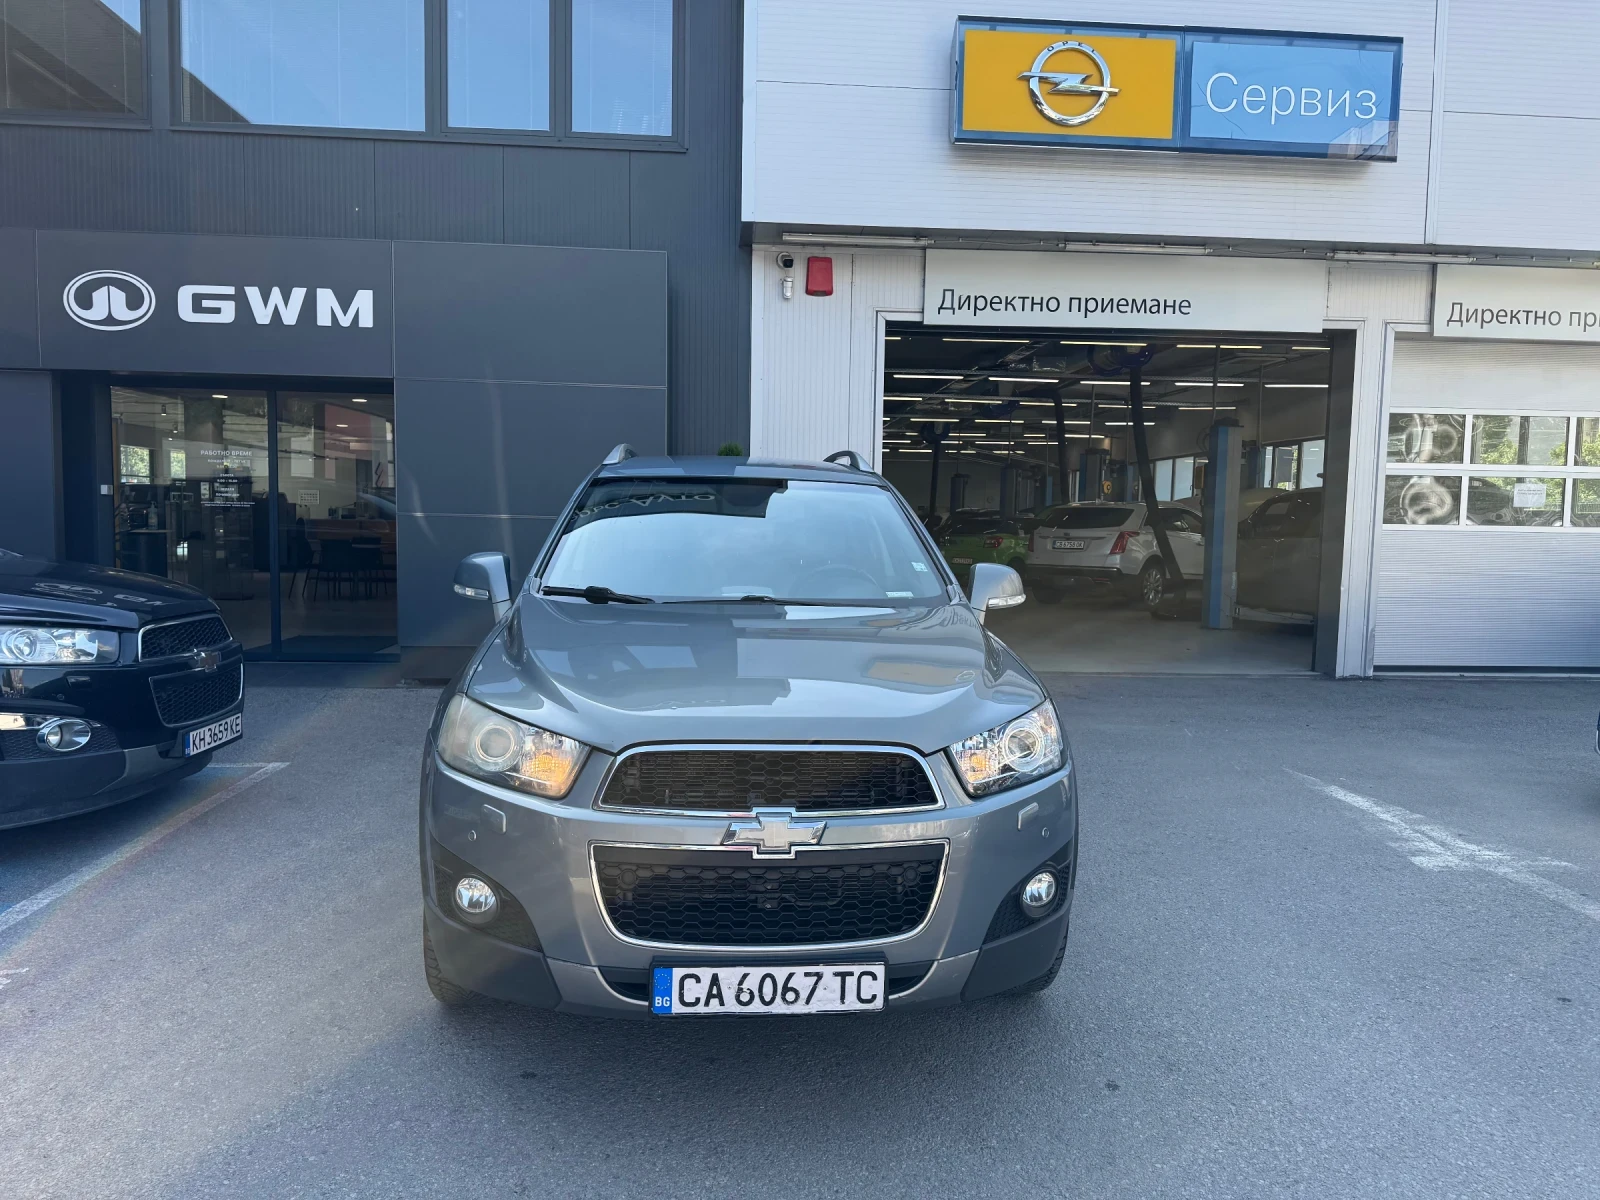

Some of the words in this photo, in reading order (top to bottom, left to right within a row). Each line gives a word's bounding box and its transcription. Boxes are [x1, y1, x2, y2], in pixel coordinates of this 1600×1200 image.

[1046, 40, 1097, 55] OPEL
[1206, 72, 1377, 125] Сервиз
[177, 284, 374, 328] GWM
[938, 288, 1061, 316] Директно
[1068, 296, 1192, 318] приемане
[1446, 302, 1562, 329] Директно
[1569, 311, 1600, 332] пр
[192, 729, 206, 752] KH
[207, 721, 229, 746] 3659
[229, 715, 241, 736] KE
[655, 996, 671, 1007] BG
[678, 973, 725, 1007] CA
[734, 971, 824, 1006] 6067
[833, 970, 878, 1004] TC
